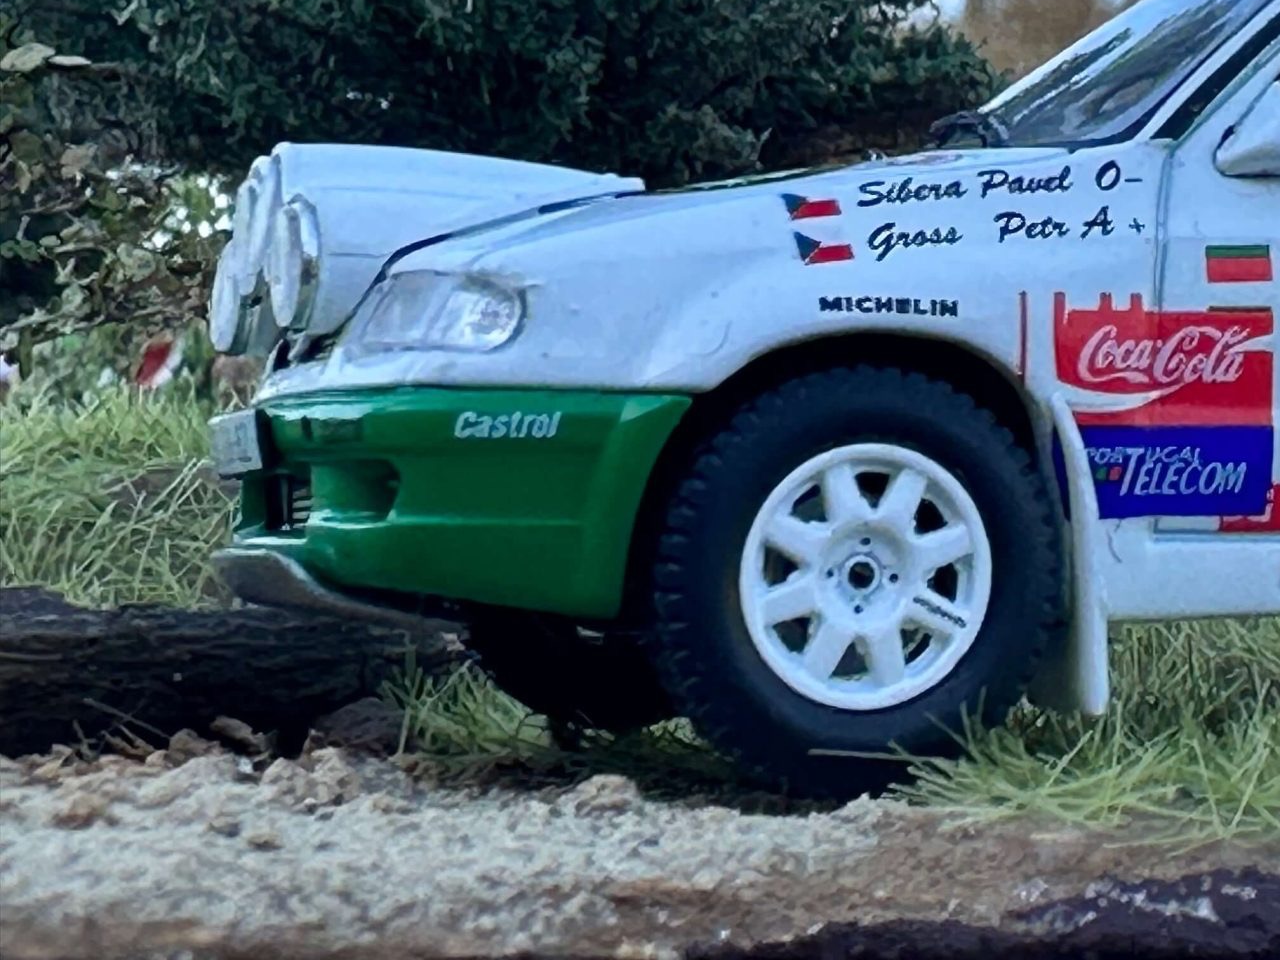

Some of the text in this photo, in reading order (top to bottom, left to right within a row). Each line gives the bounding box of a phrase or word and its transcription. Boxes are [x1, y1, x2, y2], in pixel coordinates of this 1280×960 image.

[867, 222, 963, 262] Gross
[819, 296, 958, 317] MICHELIN
[454, 410, 562, 439] Castrol
